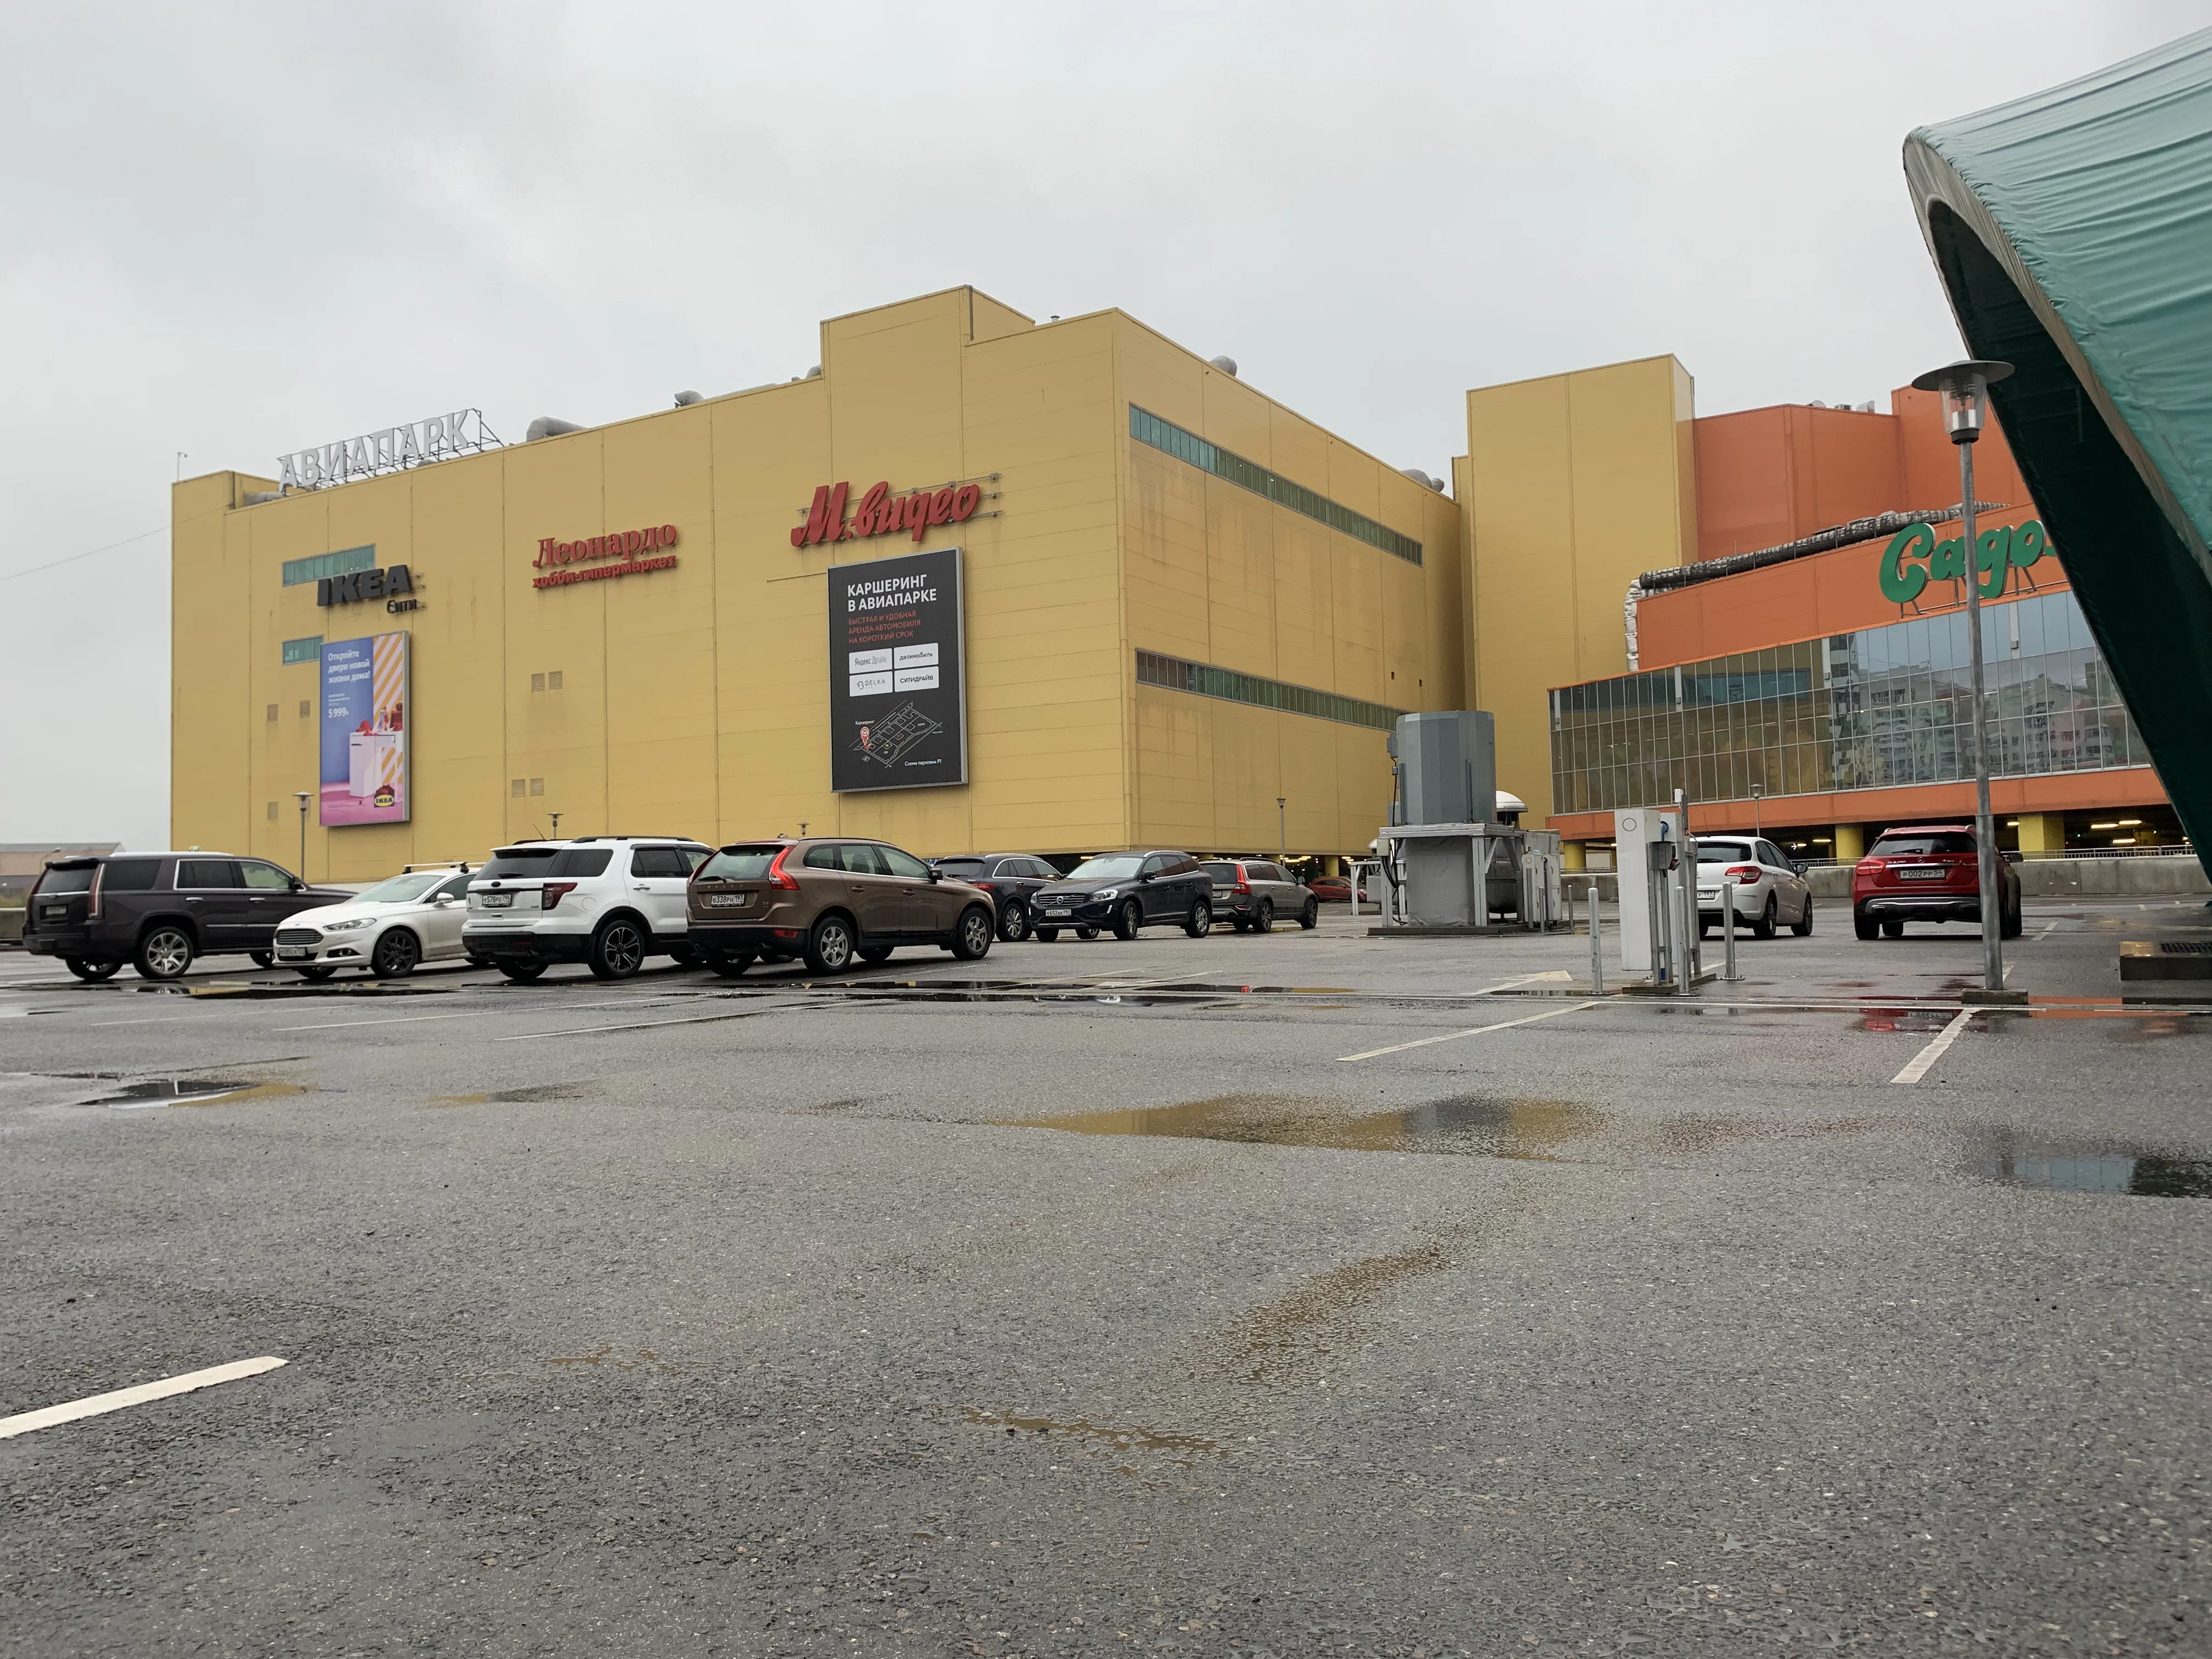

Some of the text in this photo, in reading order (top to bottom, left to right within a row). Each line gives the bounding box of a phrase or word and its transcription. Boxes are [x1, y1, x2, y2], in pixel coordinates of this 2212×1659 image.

[279, 409, 470, 492] АВИАПАРК
[532, 524, 676, 568] Леонардо
[1879, 520, 2057, 603] Садо
[532, 555, 676, 588] хобби-гипермаркет
[317, 565, 412, 606] IKEA
[848, 574, 927, 597] КАРШЕРИНГ
[848, 588, 937, 612] В АВИАПАРКЕ
[848, 616, 878, 625] БЫСТРАЯ
[885, 611, 916, 621] УДОБНАЯ
[848, 619, 921, 634] АРЕНДА АВТОМОБИЛЯ
[859, 631, 894, 642] КОРОТКИЙ
[328, 650, 359, 662] Откройте
[900, 652, 933, 661] делимобиль
[328, 658, 370, 674] двери новой
[328, 670, 370, 684] жизни дома!
[900, 675, 934, 683] СИТИДРАЙВ
